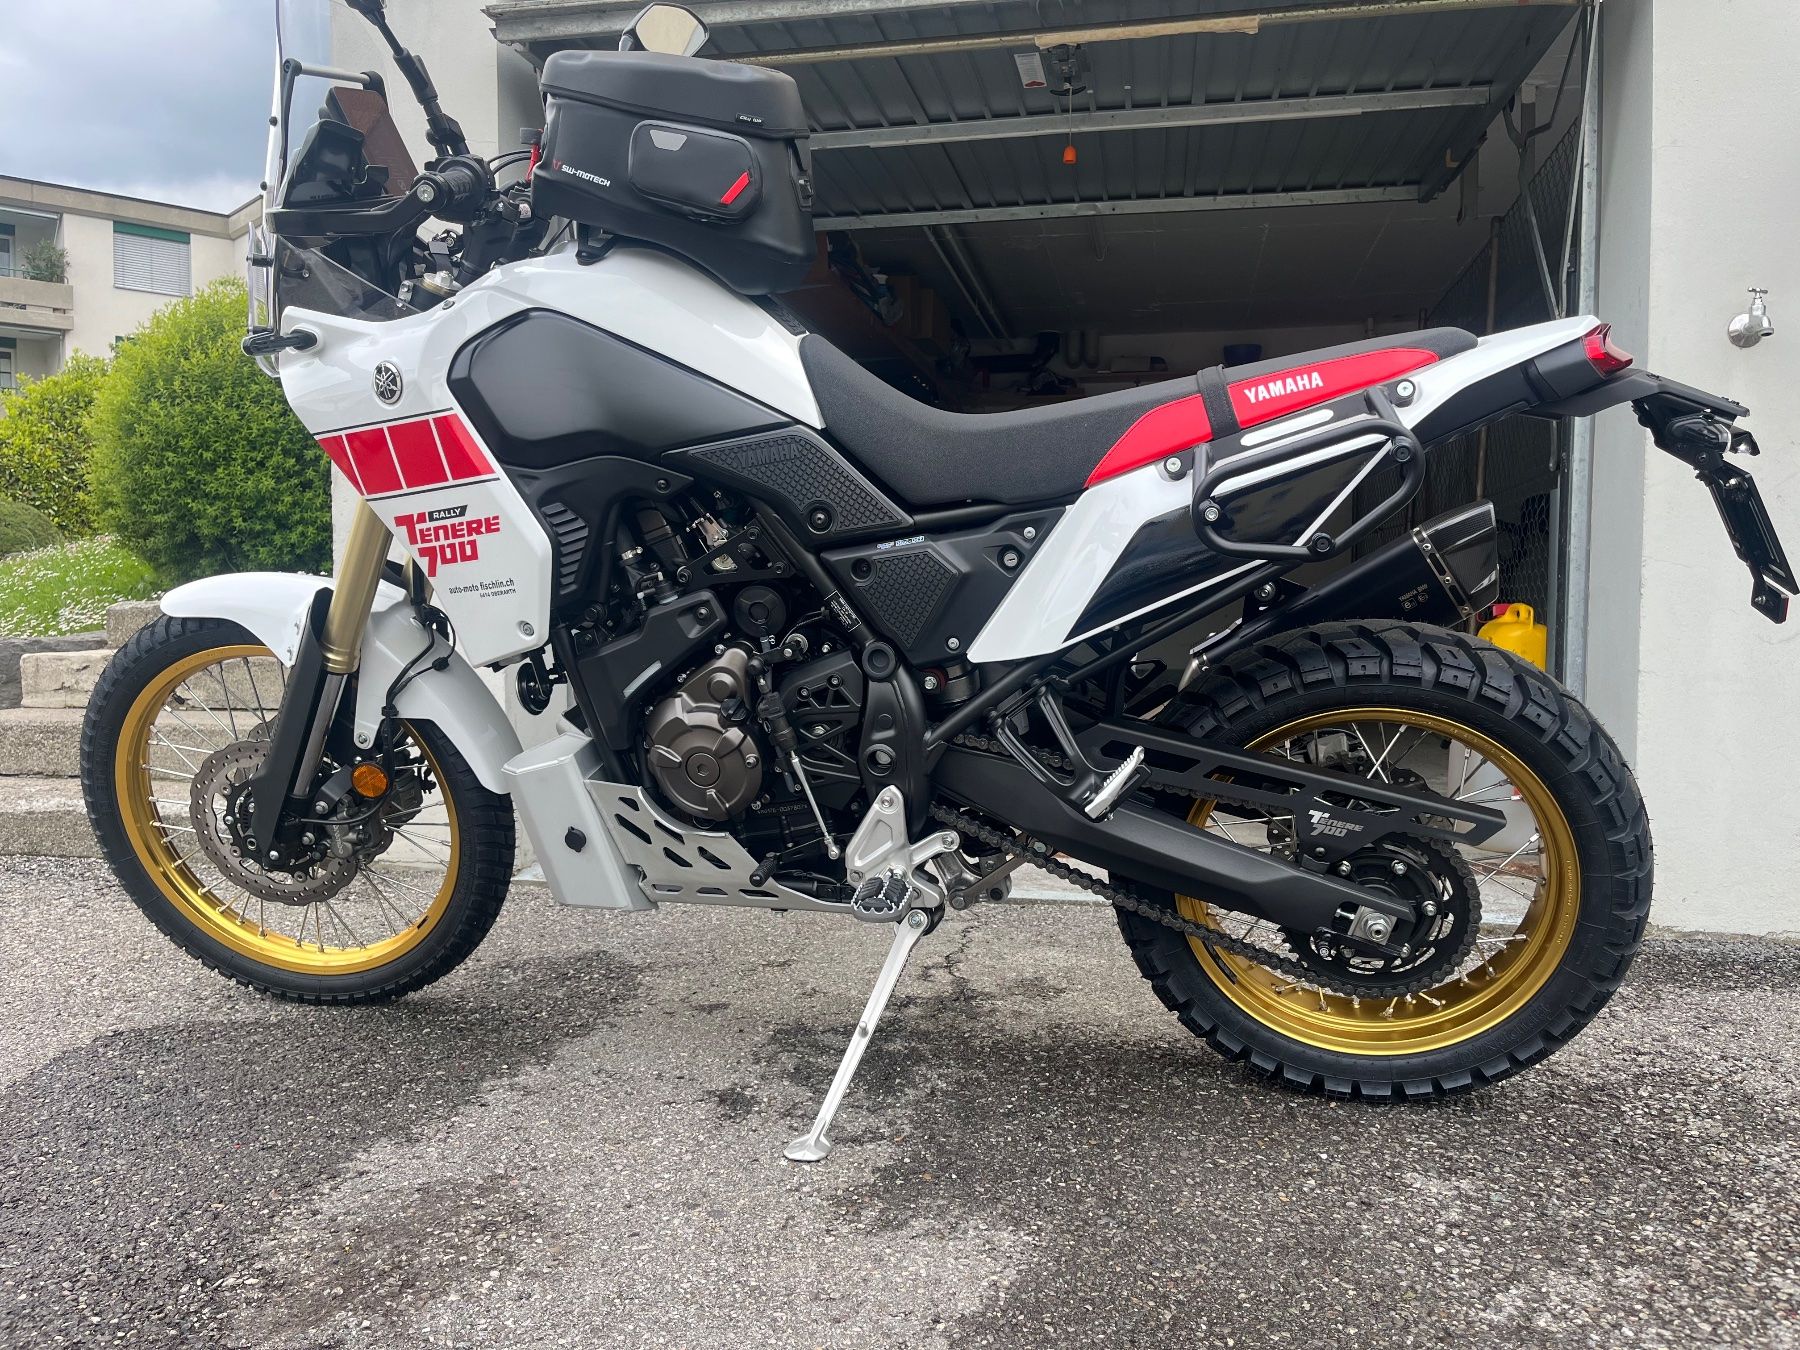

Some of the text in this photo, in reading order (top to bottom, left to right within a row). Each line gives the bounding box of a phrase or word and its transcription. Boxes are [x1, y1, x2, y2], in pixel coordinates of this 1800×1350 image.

[561, 164, 611, 187] SW-MOTECH
[1243, 371, 1324, 404] YAMAHA
[735, 443, 800, 468] YAMAHA
[433, 508, 461, 520] RALLY
[418, 539, 479, 578] 700
[449, 578, 515, 594] auto-moto fischlin.ch
[1310, 824, 1348, 837] 700
